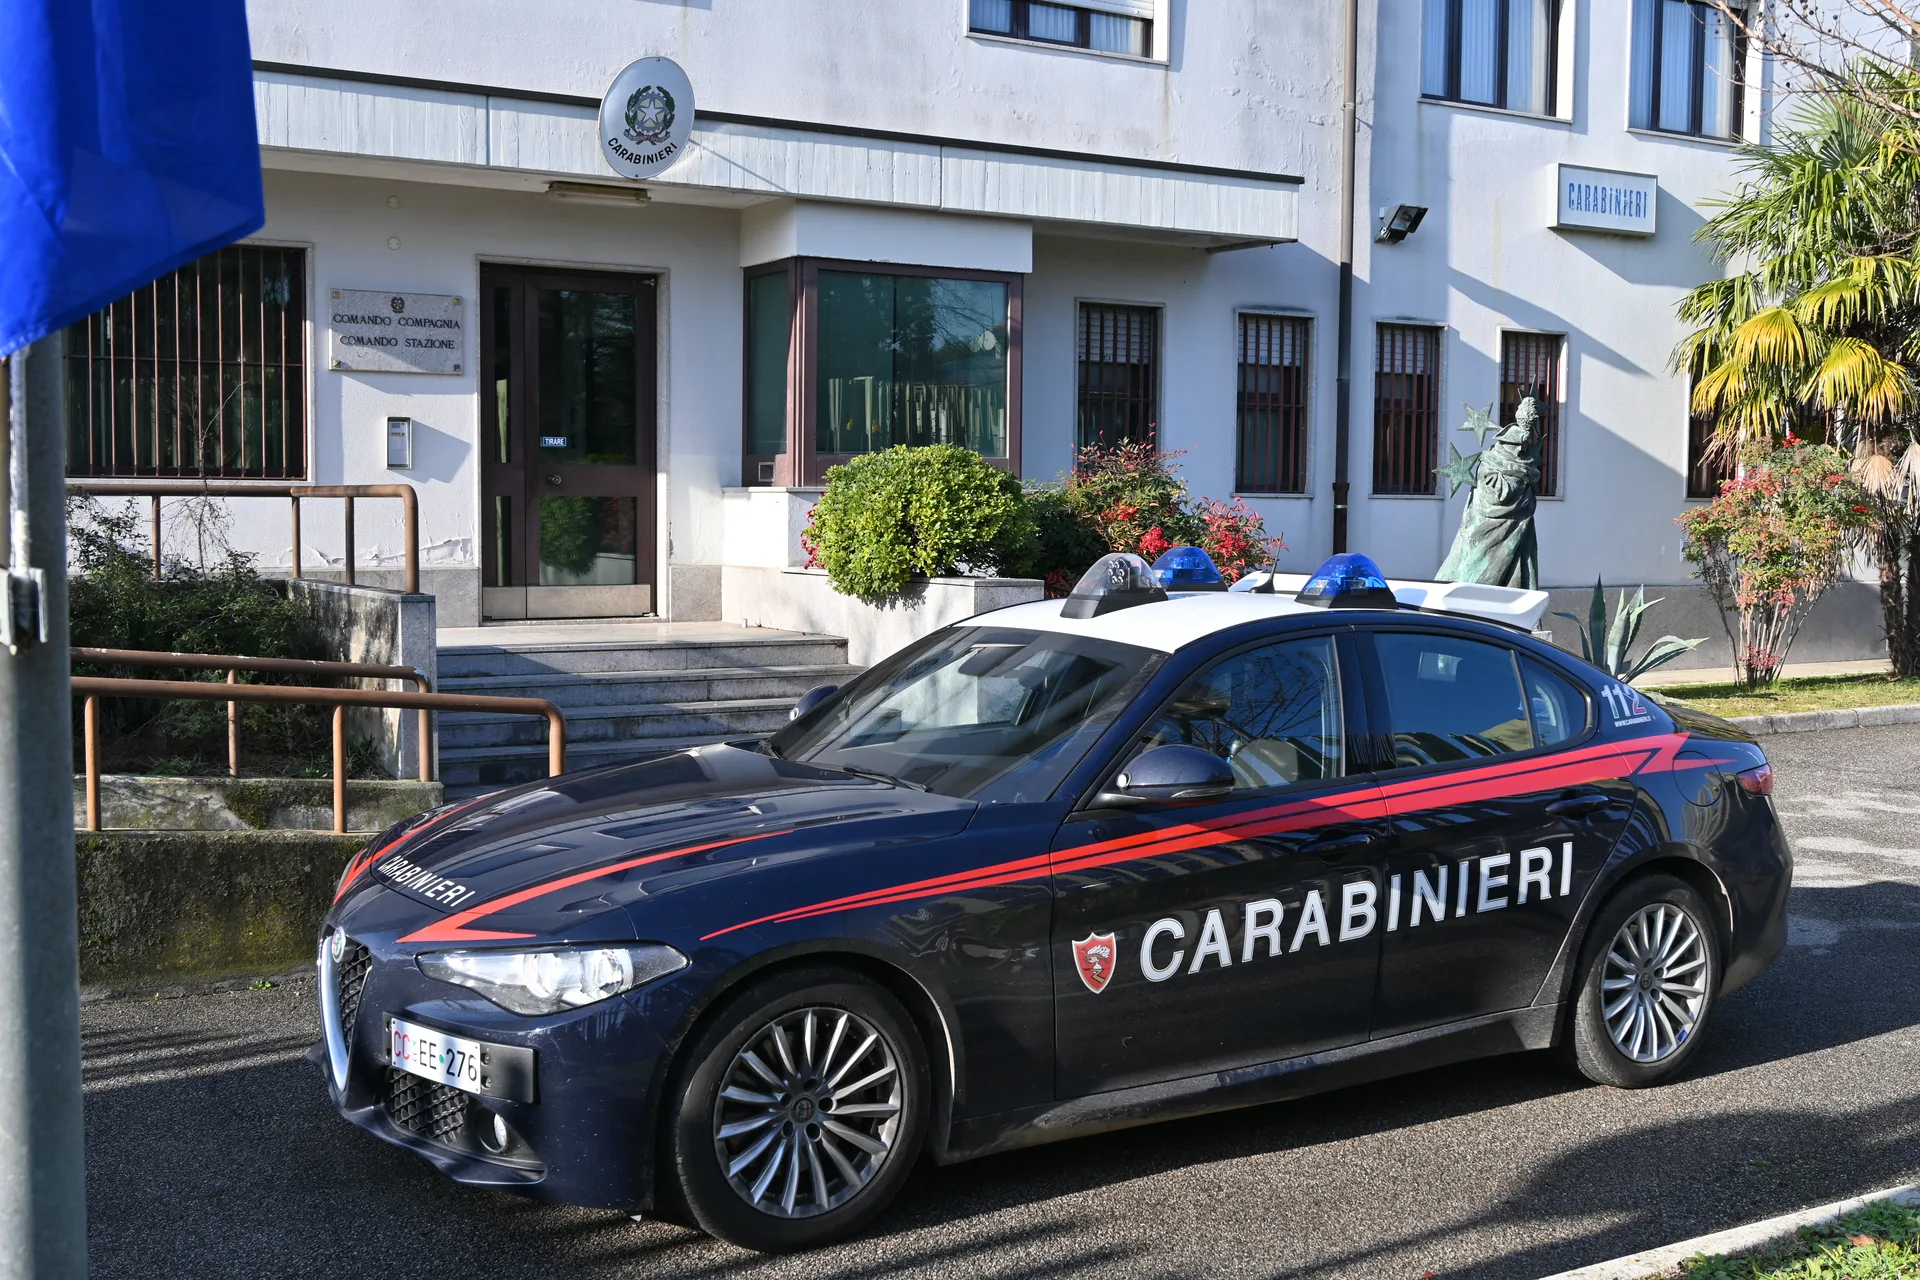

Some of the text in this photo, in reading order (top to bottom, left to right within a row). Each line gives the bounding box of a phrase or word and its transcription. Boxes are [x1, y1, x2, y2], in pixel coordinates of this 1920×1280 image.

[607, 137, 678, 165] CARABINIERI
[1568, 182, 1647, 218] CARABINIERI
[333, 313, 460, 329] COMANDO COMPAGNIA
[340, 335, 455, 349] COMANDO STAZIONE
[1601, 684, 1647, 719] 112
[377, 855, 476, 907] CARABINIERI
[1139, 841, 1573, 983] CARABINIERI
[393, 1030, 477, 1082] CC EE 276
